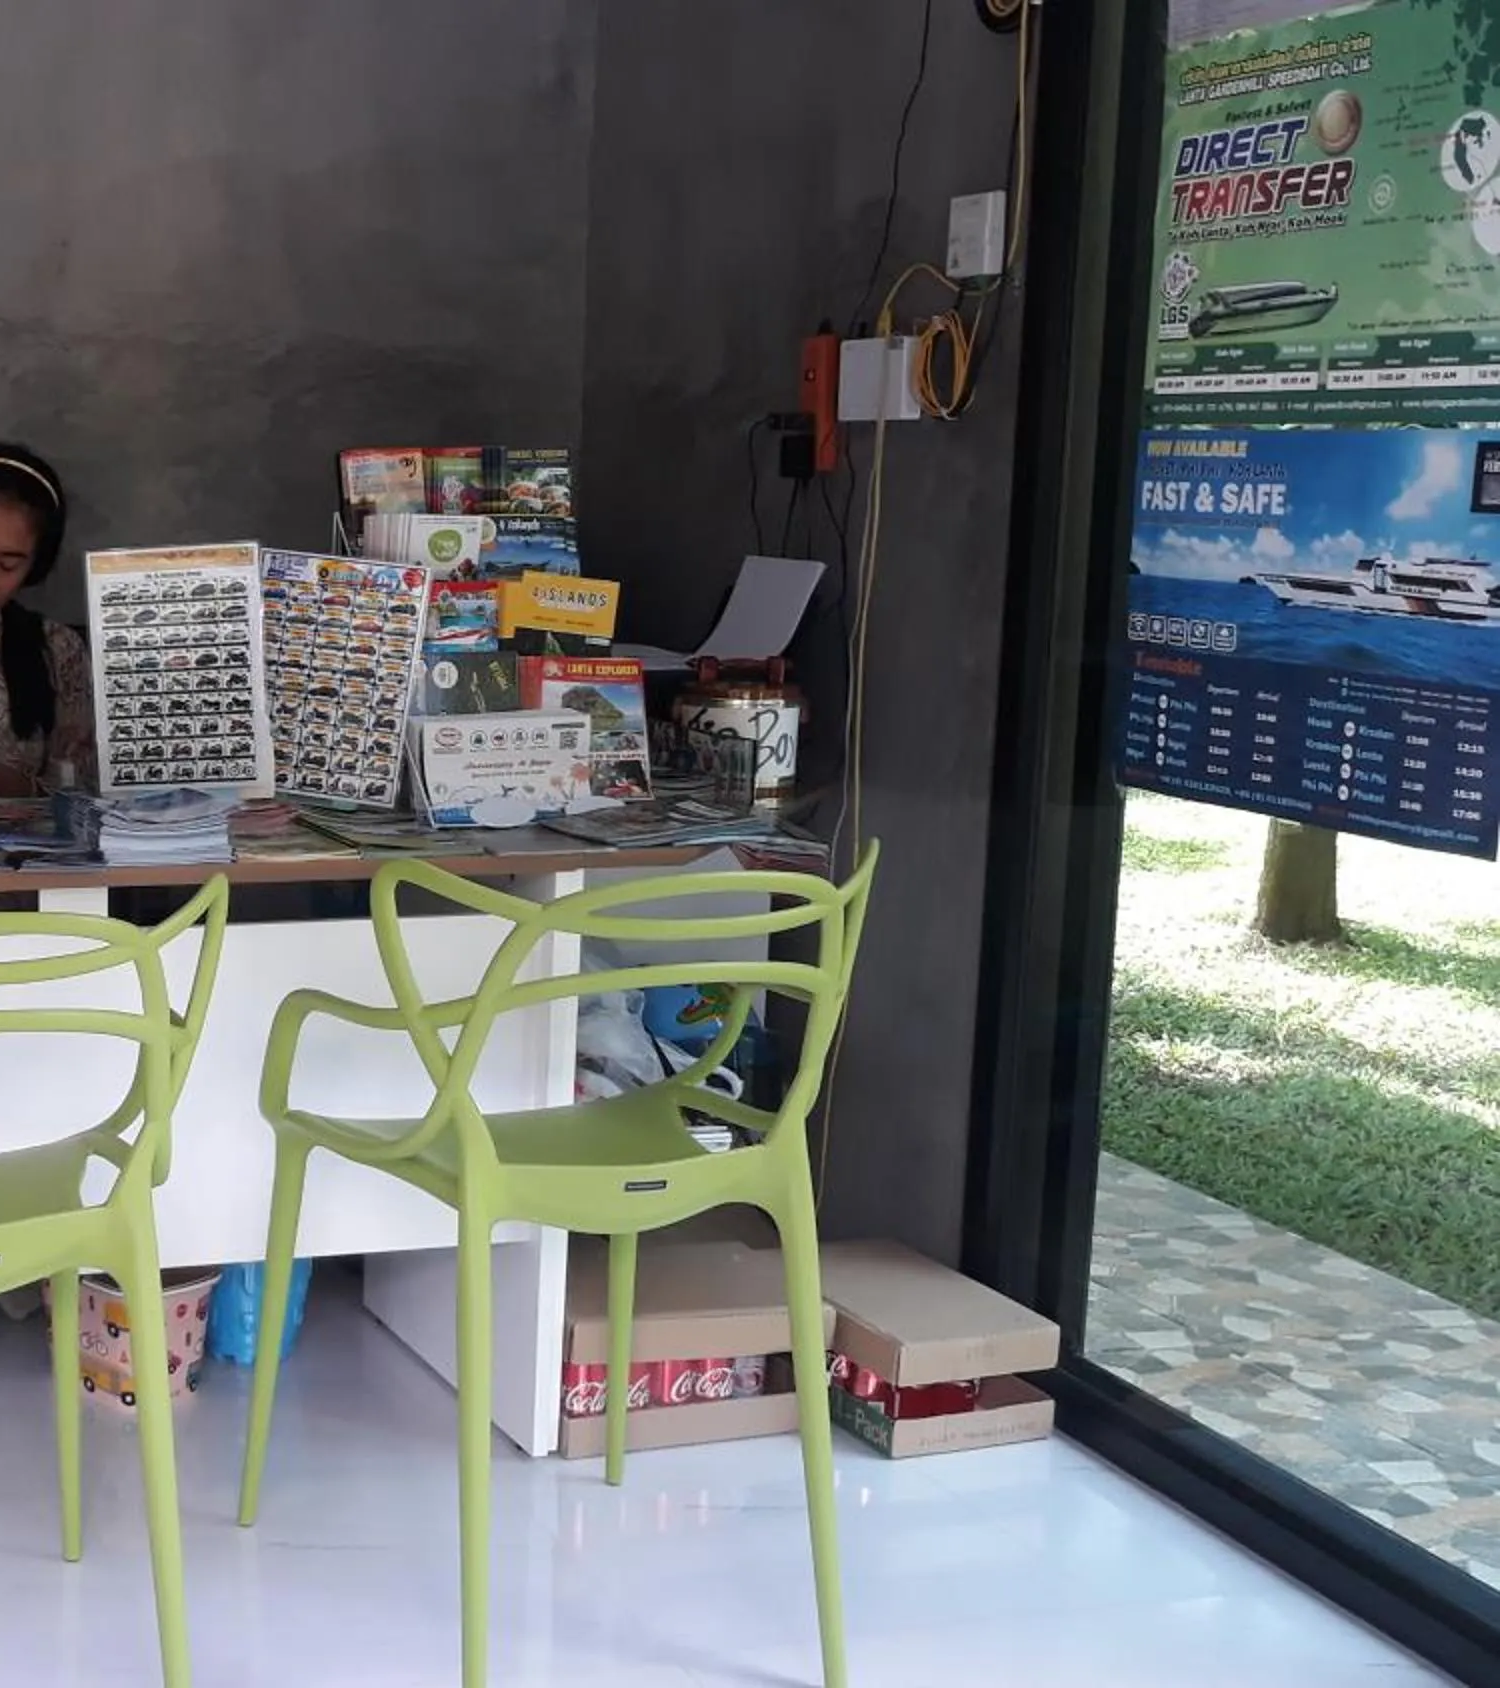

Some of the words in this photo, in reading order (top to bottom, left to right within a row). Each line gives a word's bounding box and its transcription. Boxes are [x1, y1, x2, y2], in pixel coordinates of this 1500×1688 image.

[1172, 116, 1308, 178] DIRECT
[1171, 158, 1355, 225] TRANSFER
[1160, 305, 1189, 325] LGS
[1172, 439, 1249, 460] AVAILABLE
[1141, 481, 1191, 512] FAST
[1194, 482, 1215, 514] &
[1220, 483, 1288, 516] SAFE
